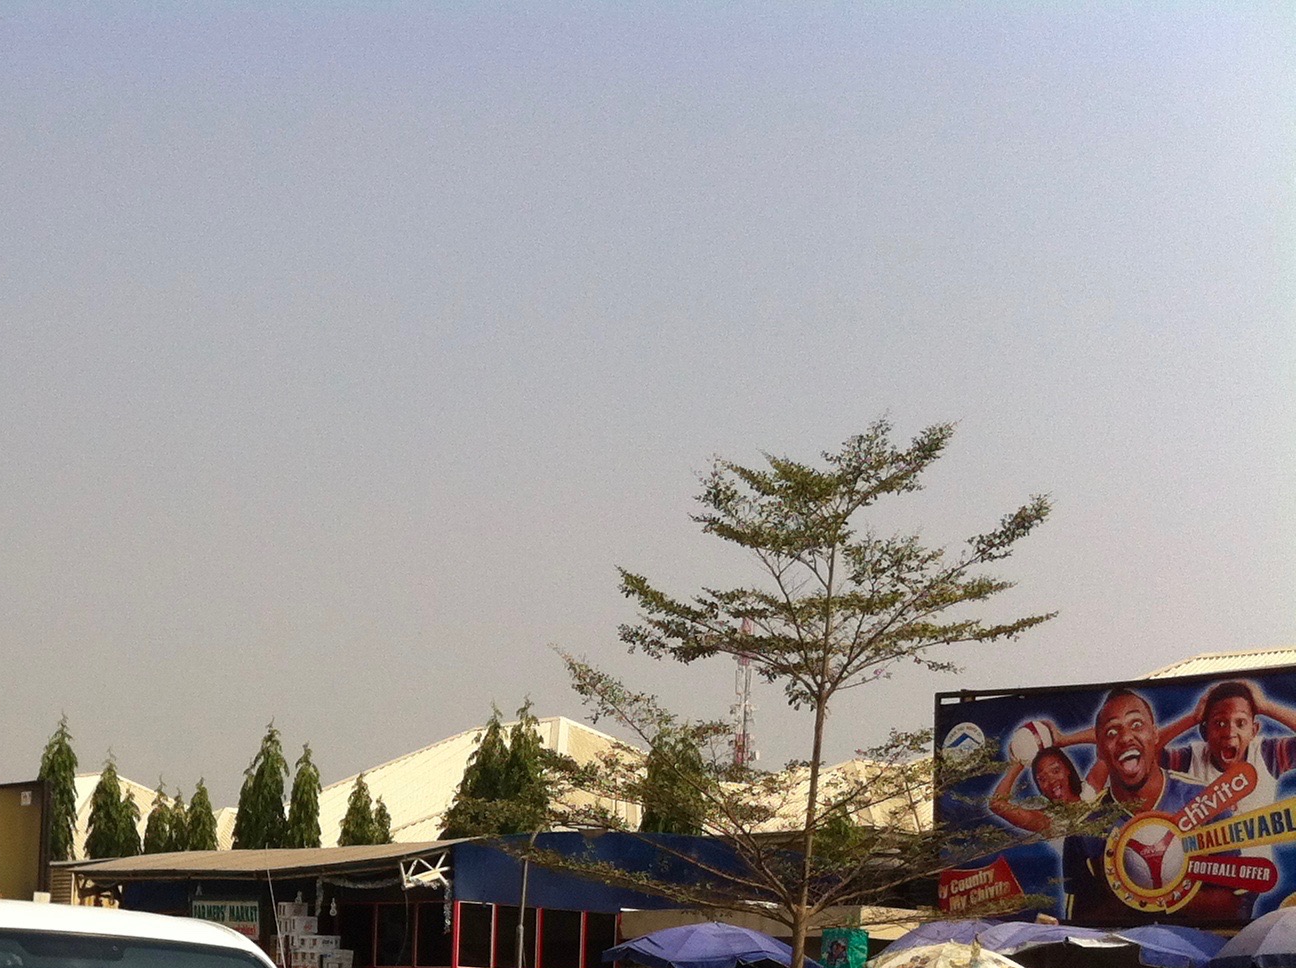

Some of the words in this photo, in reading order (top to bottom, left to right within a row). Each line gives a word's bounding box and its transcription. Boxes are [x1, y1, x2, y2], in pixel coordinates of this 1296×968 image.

[1177, 773, 1250, 832] chivita
[950, 869, 995, 894] Country
[1188, 860, 1237, 878] FOOTBALL
[1239, 865, 1270, 881] OFFER
[229, 905, 257, 921] MARKET
